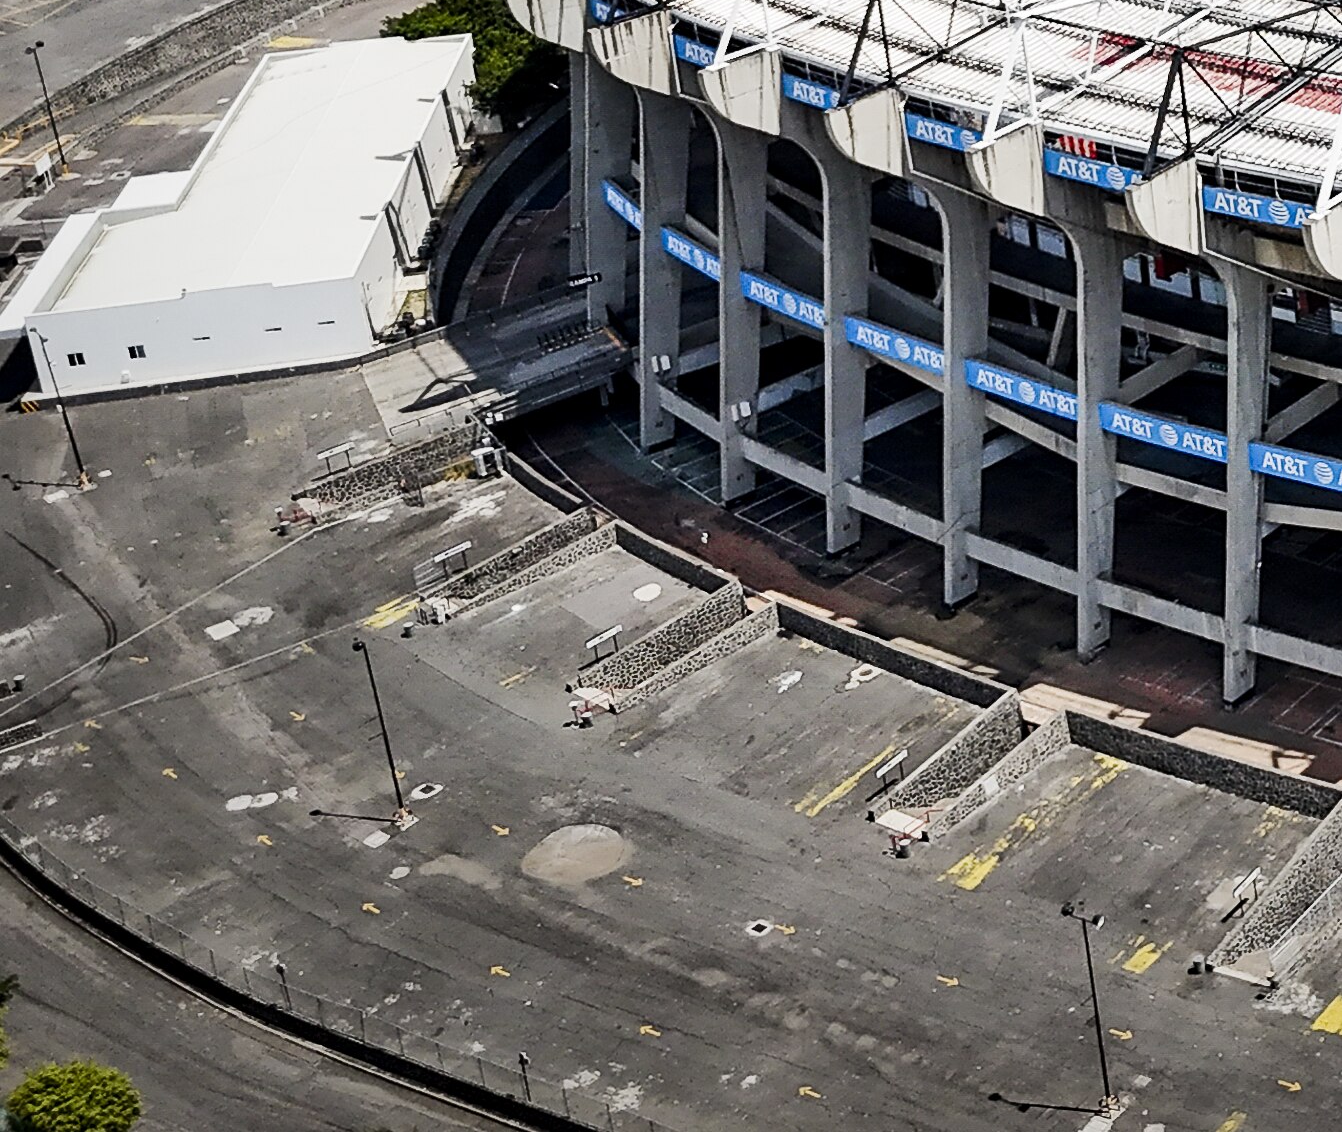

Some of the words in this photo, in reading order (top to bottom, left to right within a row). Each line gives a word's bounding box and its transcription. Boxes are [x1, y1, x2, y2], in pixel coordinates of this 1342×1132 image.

[793, 81, 826, 106] AT&T
[916, 120, 954, 145] AT&T
[1058, 156, 1100, 182] AT&T
[1214, 193, 1262, 218] AT&T
[750, 281, 779, 306] AT&T
[856, 326, 891, 352] AT&T
[977, 369, 1014, 395] AT&T
[1039, 390, 1077, 415] AT&T
[1112, 413, 1153, 438] AT&T
[1182, 432, 1228, 458] AT&T
[1262, 452, 1307, 477] AT&T
